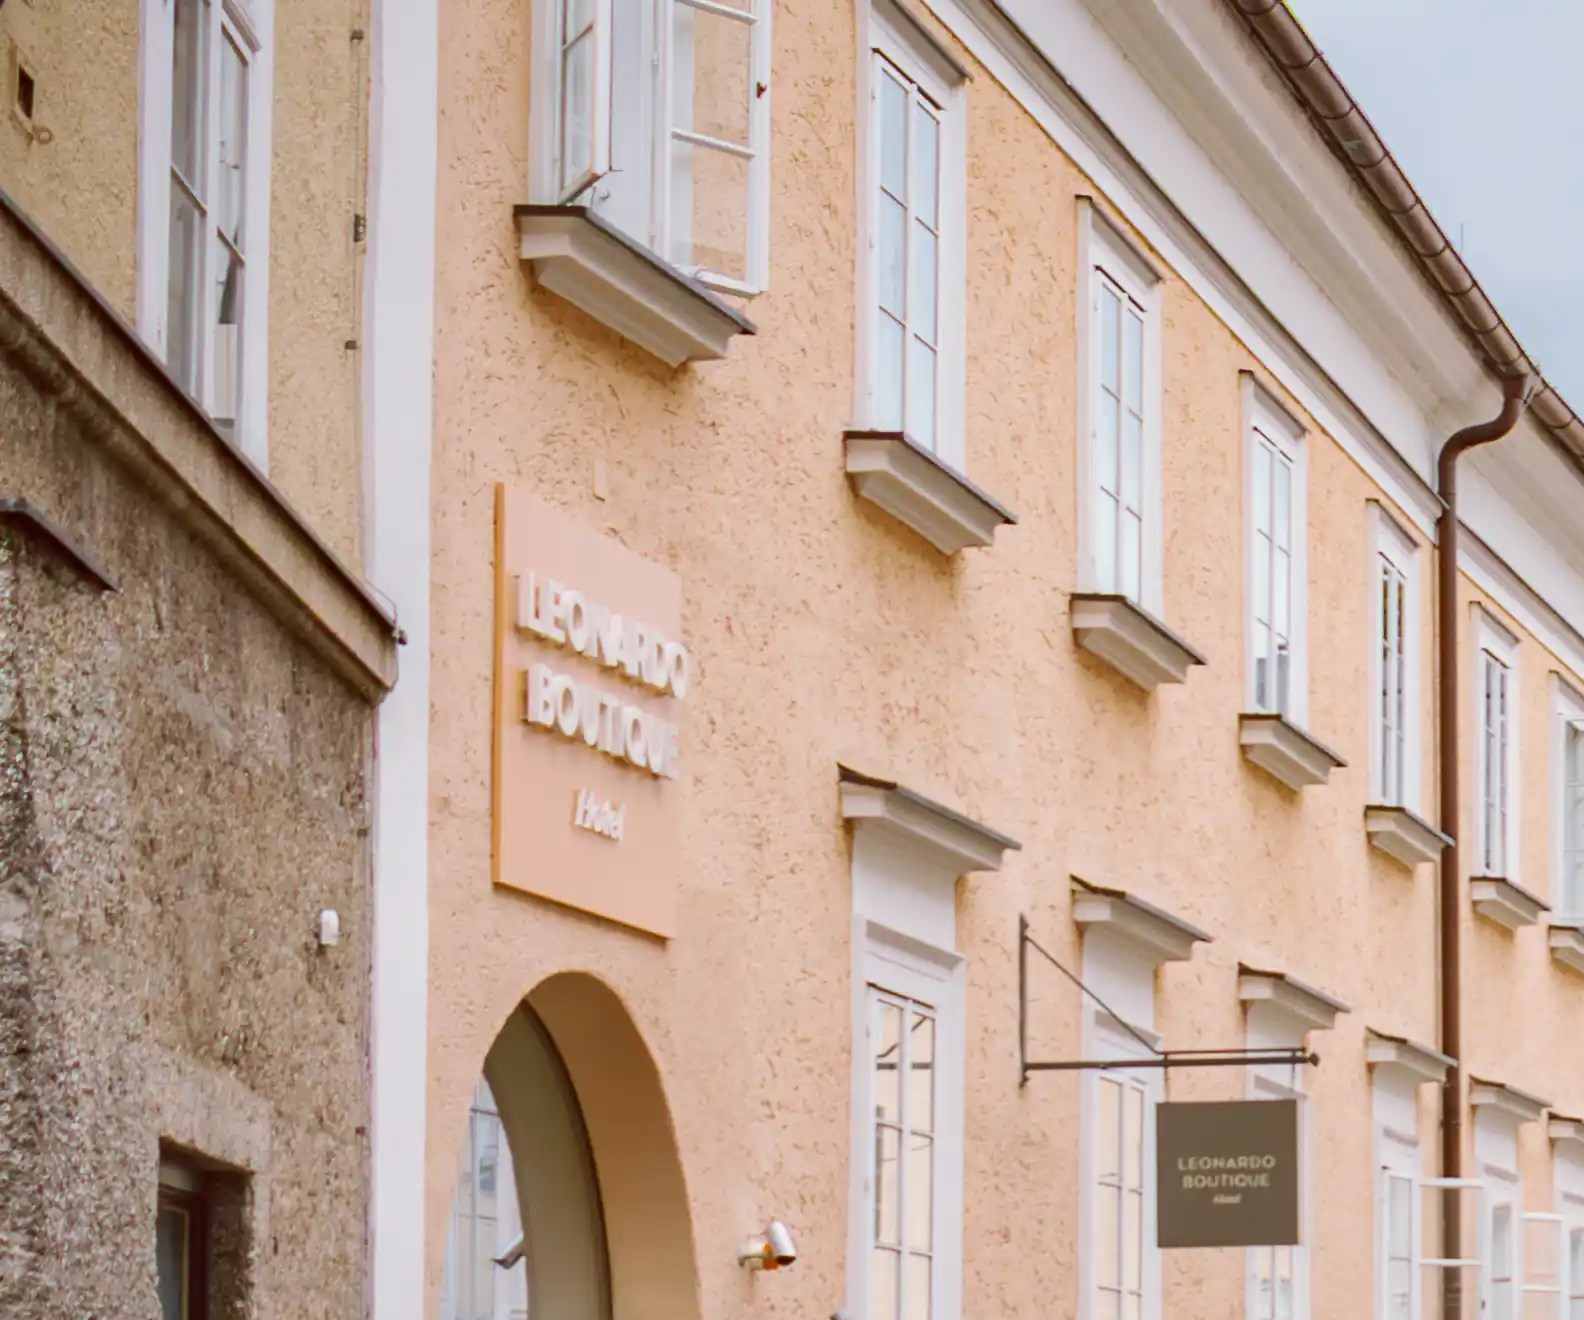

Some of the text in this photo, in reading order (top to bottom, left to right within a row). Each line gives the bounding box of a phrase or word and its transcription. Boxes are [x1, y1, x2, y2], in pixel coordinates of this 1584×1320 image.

[518, 570, 688, 699] LEONARDO
[527, 663, 679, 780] BOUTIQUE
[574, 787, 625, 841] Hotel
[1177, 1155, 1276, 1170] LEONARDO
[1182, 1173, 1271, 1188] BOUTIQUE
